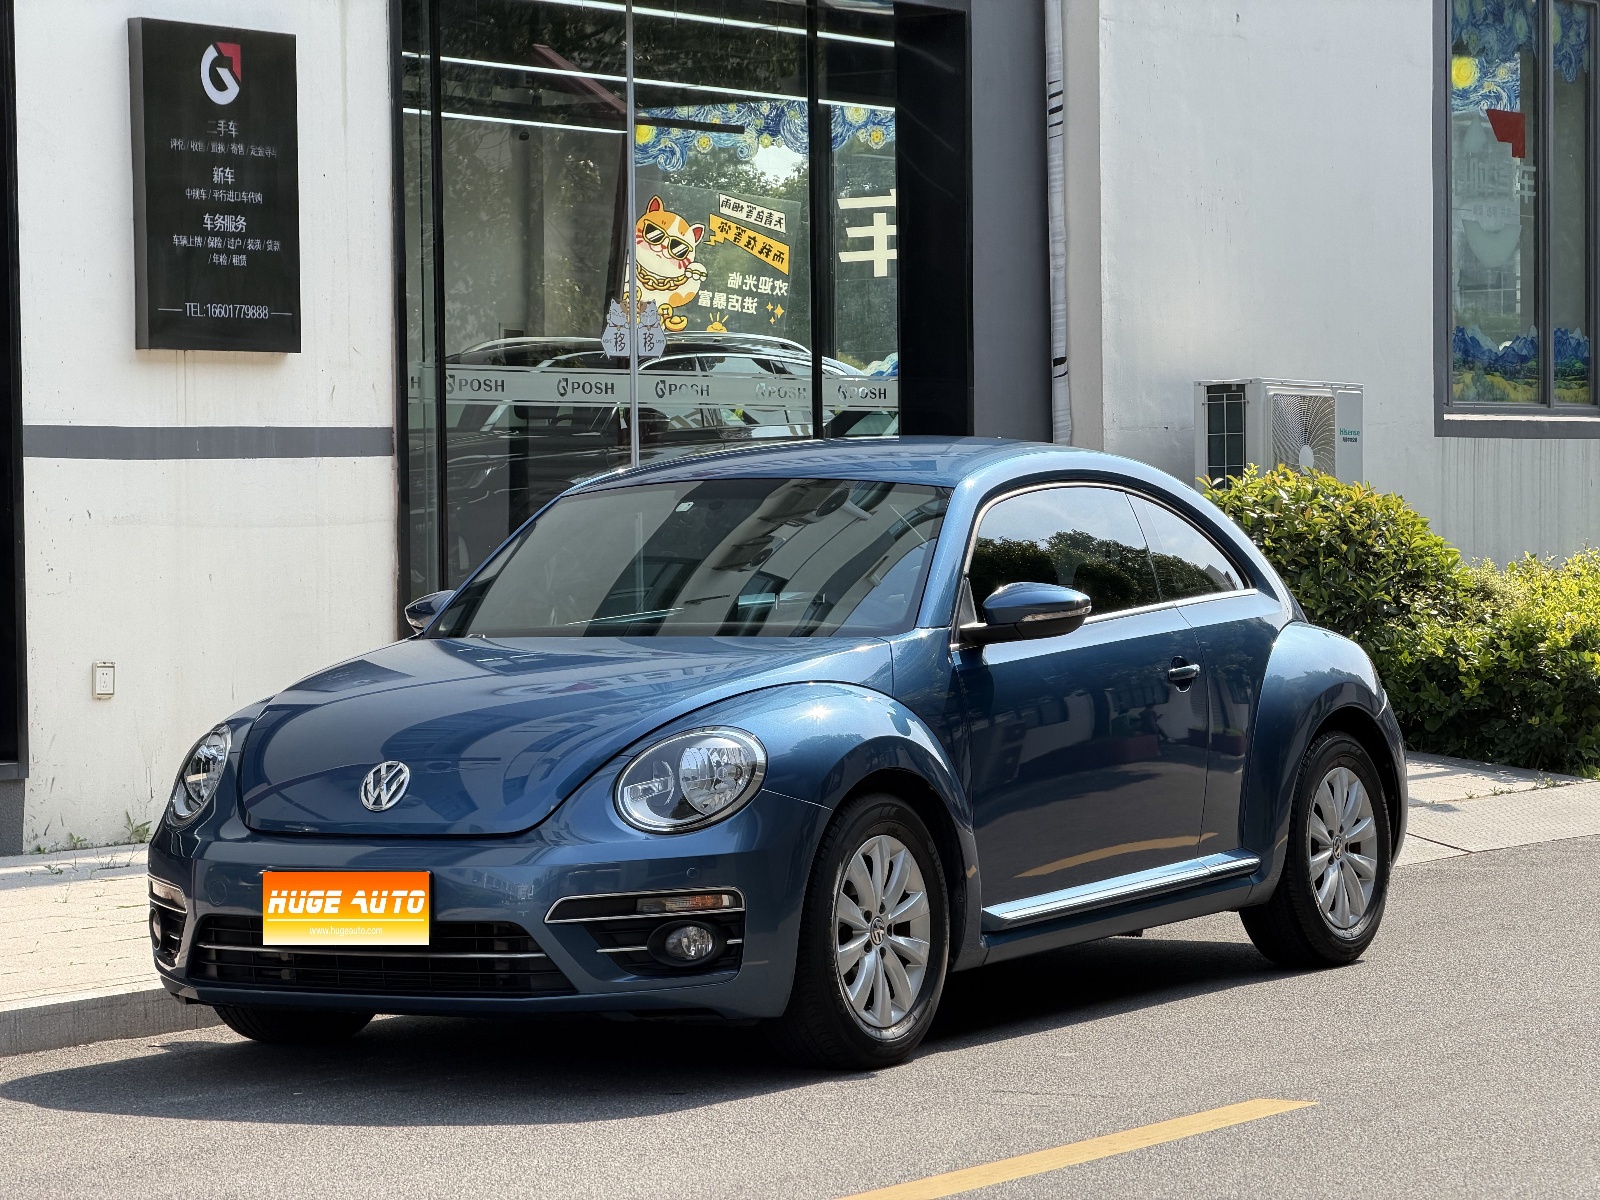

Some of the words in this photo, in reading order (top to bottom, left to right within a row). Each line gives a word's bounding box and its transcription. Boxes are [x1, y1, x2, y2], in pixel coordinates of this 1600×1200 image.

[206, 120, 239, 138] 二手车
[212, 166, 236, 185] 新车
[202, 213, 247, 233] 车务服务
[613, 331, 626, 352] 移
[642, 331, 655, 352] 移
[458, 378, 505, 393] POSH
[571, 381, 615, 395] POSH
[668, 383, 710, 397] POSH
